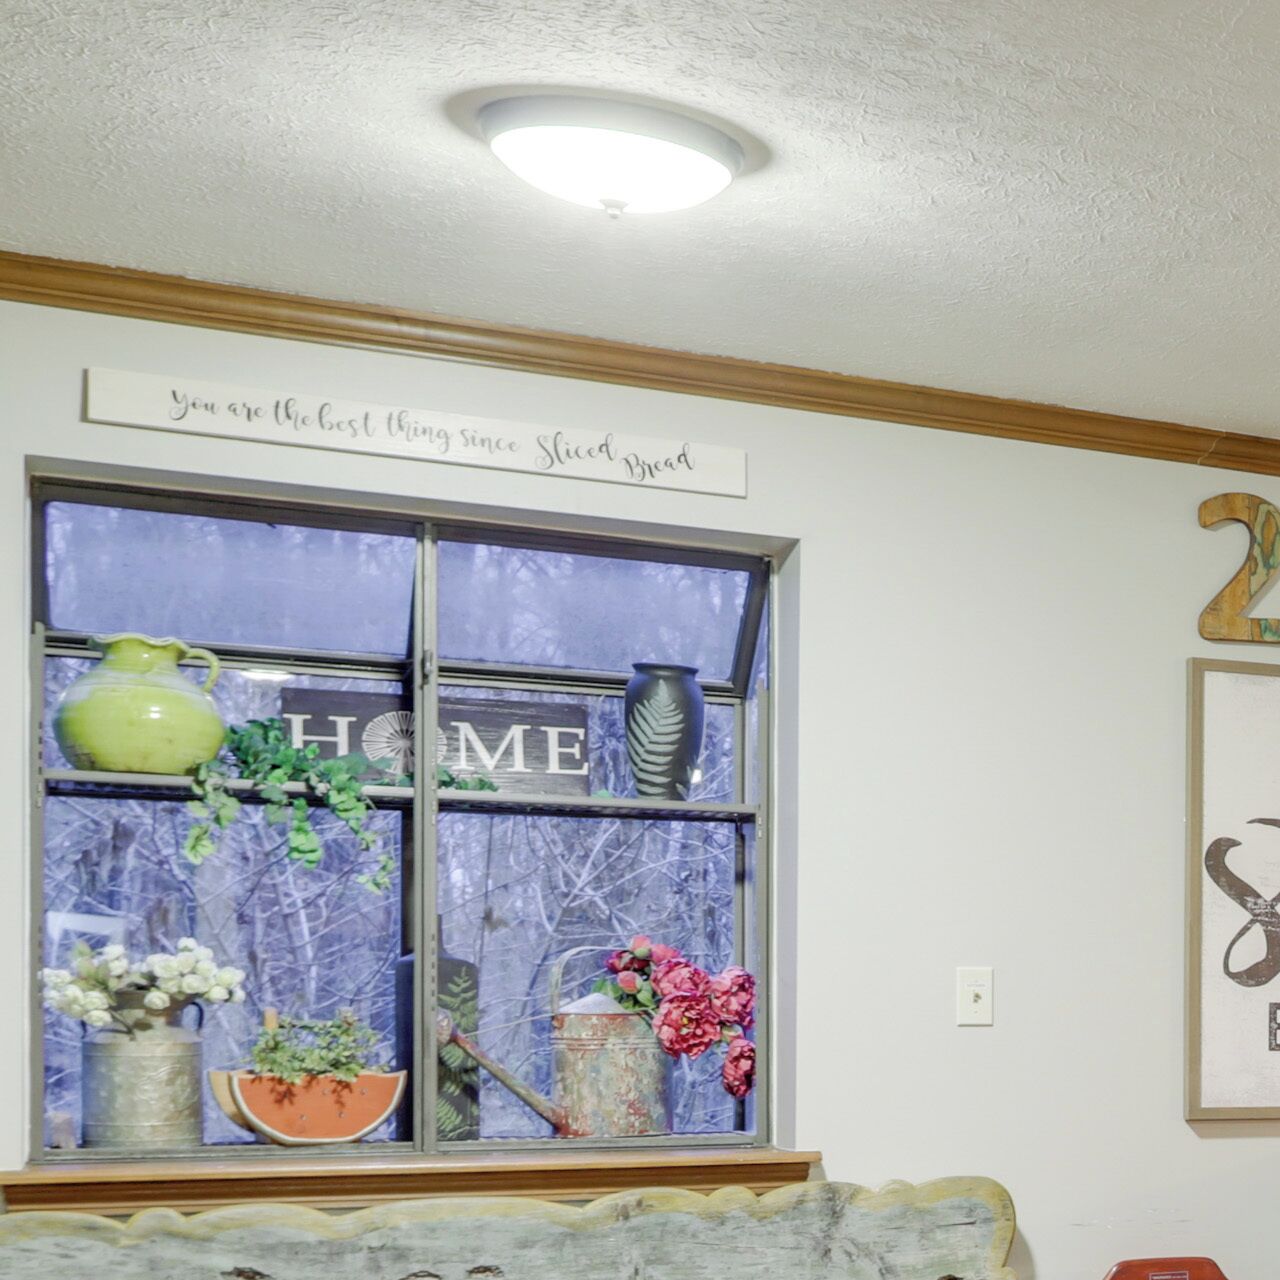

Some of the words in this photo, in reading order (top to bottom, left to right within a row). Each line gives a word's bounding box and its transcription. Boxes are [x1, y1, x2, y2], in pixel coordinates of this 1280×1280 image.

[227, 400, 265, 422] are
[273, 398, 311, 431] the
[317, 402, 376, 438] best
[386, 410, 451, 454] thing
[460, 428, 520, 454] since
[624, 443, 696, 482] Bread
